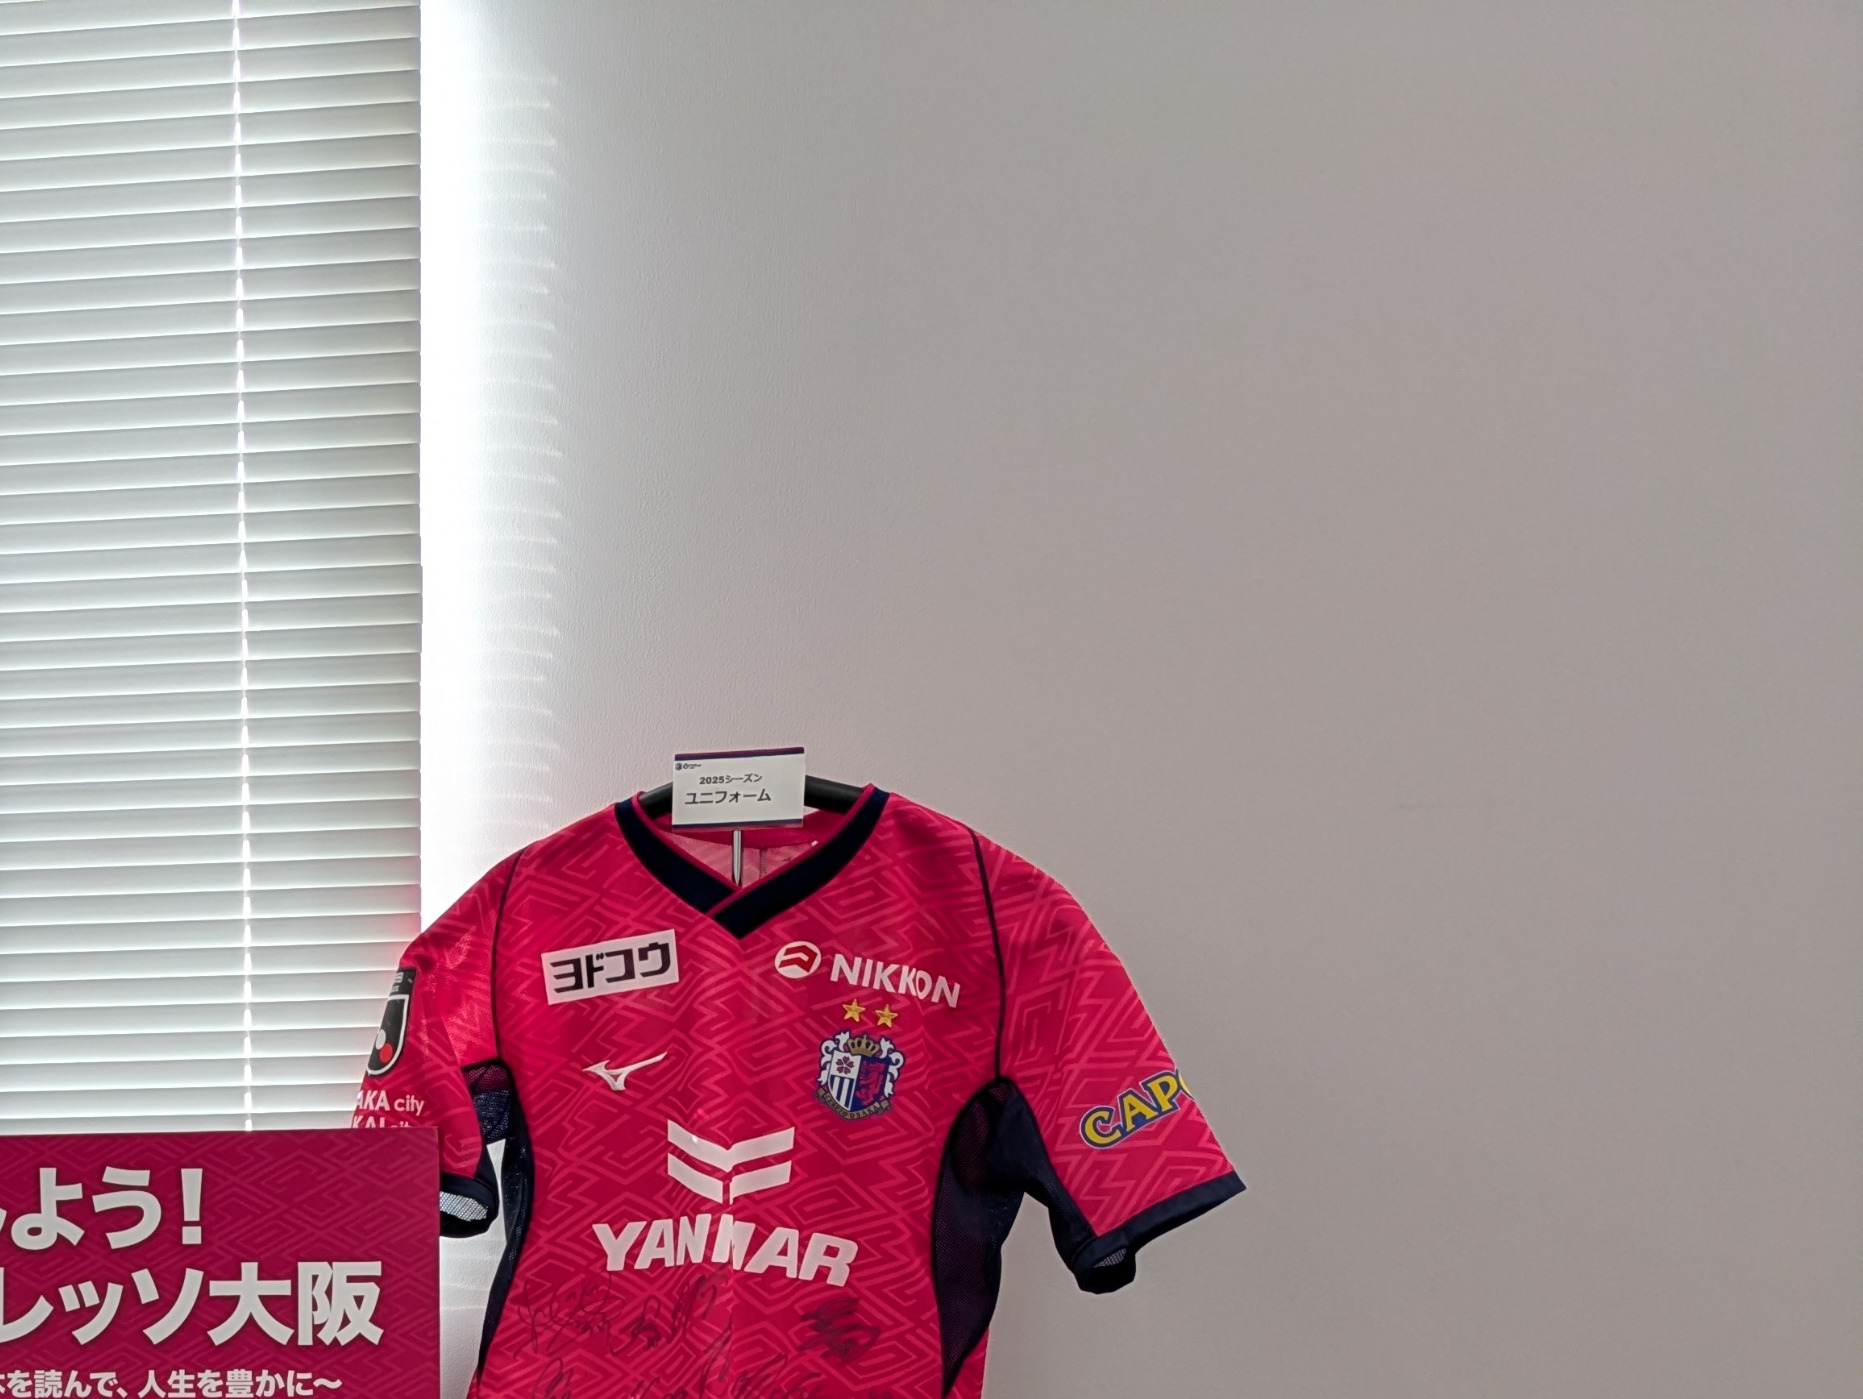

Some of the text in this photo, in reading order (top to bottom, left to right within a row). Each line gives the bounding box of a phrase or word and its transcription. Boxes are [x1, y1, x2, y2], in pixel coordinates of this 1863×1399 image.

[684, 788, 772, 806] ユニフォーム
[698, 773, 763, 785] 2025シーズン
[549, 941, 672, 994] ヨドコウ
[829, 952, 961, 1009] NIKKON
[393, 1094, 425, 1116] city
[1078, 1068, 1192, 1150] CAP
